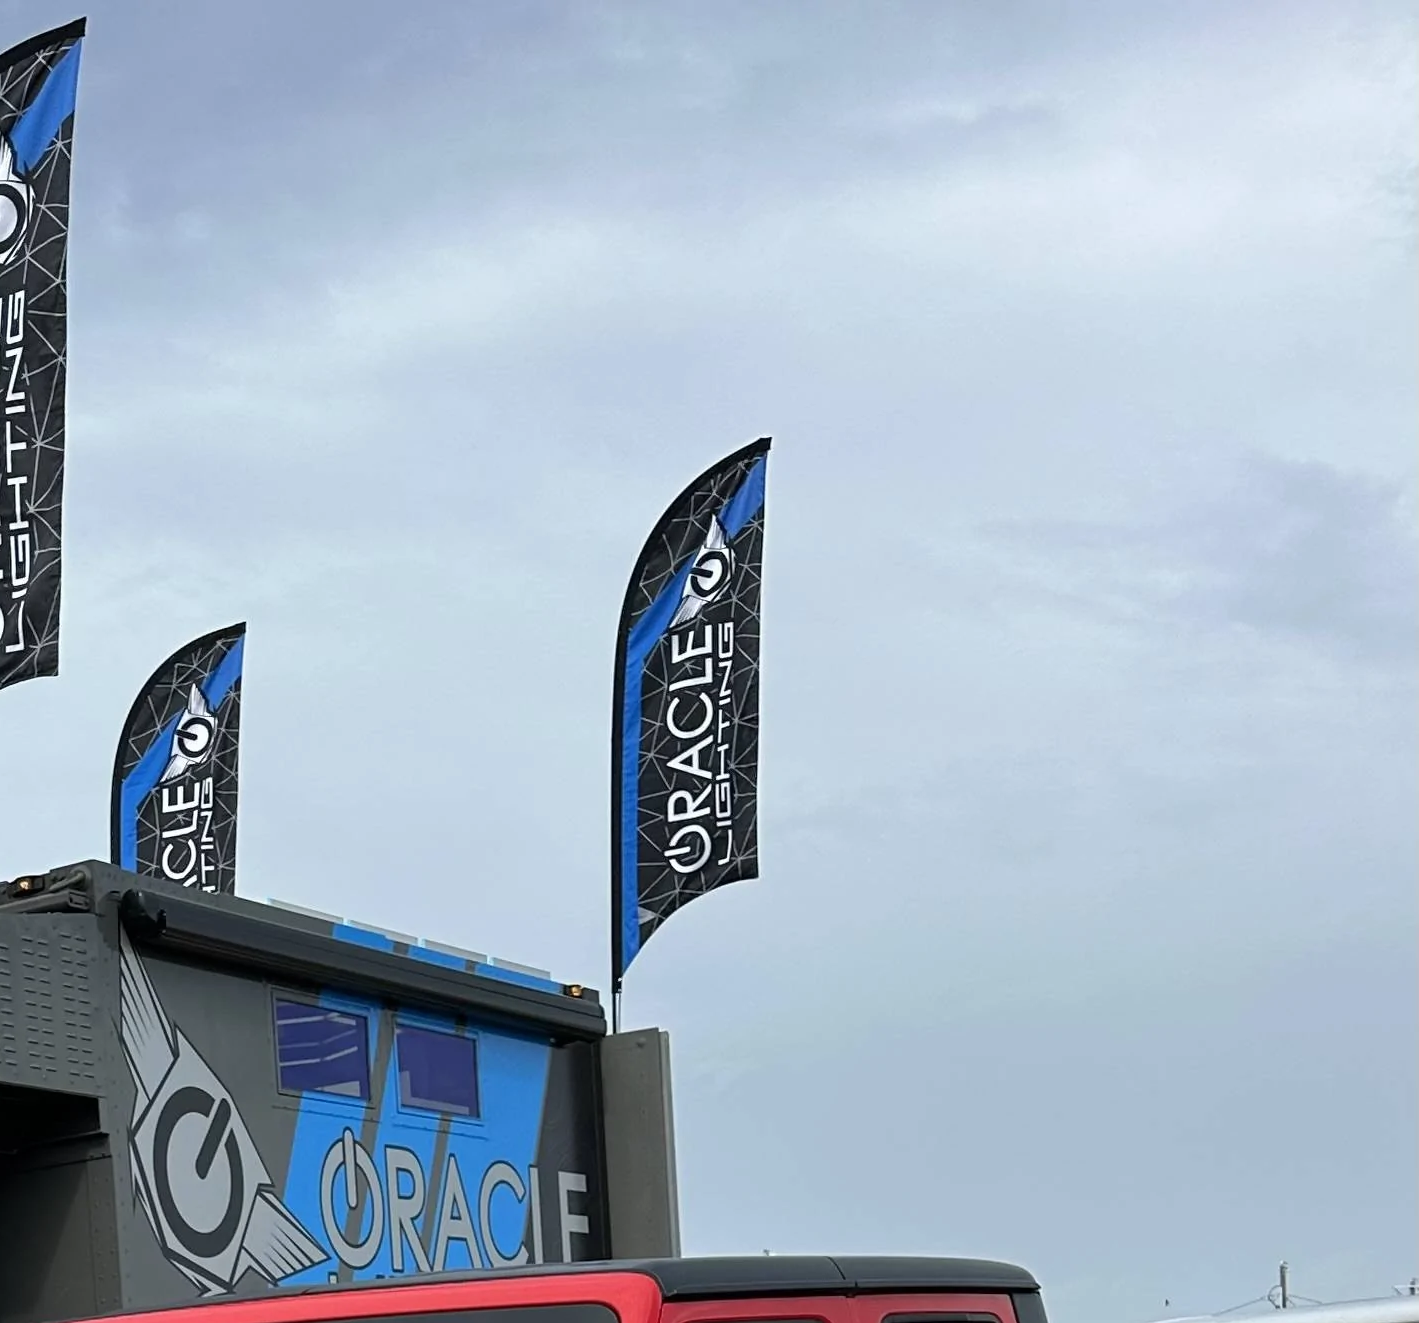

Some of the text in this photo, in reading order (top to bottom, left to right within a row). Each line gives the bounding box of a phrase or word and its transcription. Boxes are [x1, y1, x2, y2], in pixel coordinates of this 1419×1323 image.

[5, 291, 30, 653] LIGHTING
[664, 624, 715, 874] ORACLE
[715, 622, 734, 865] LIGHTING
